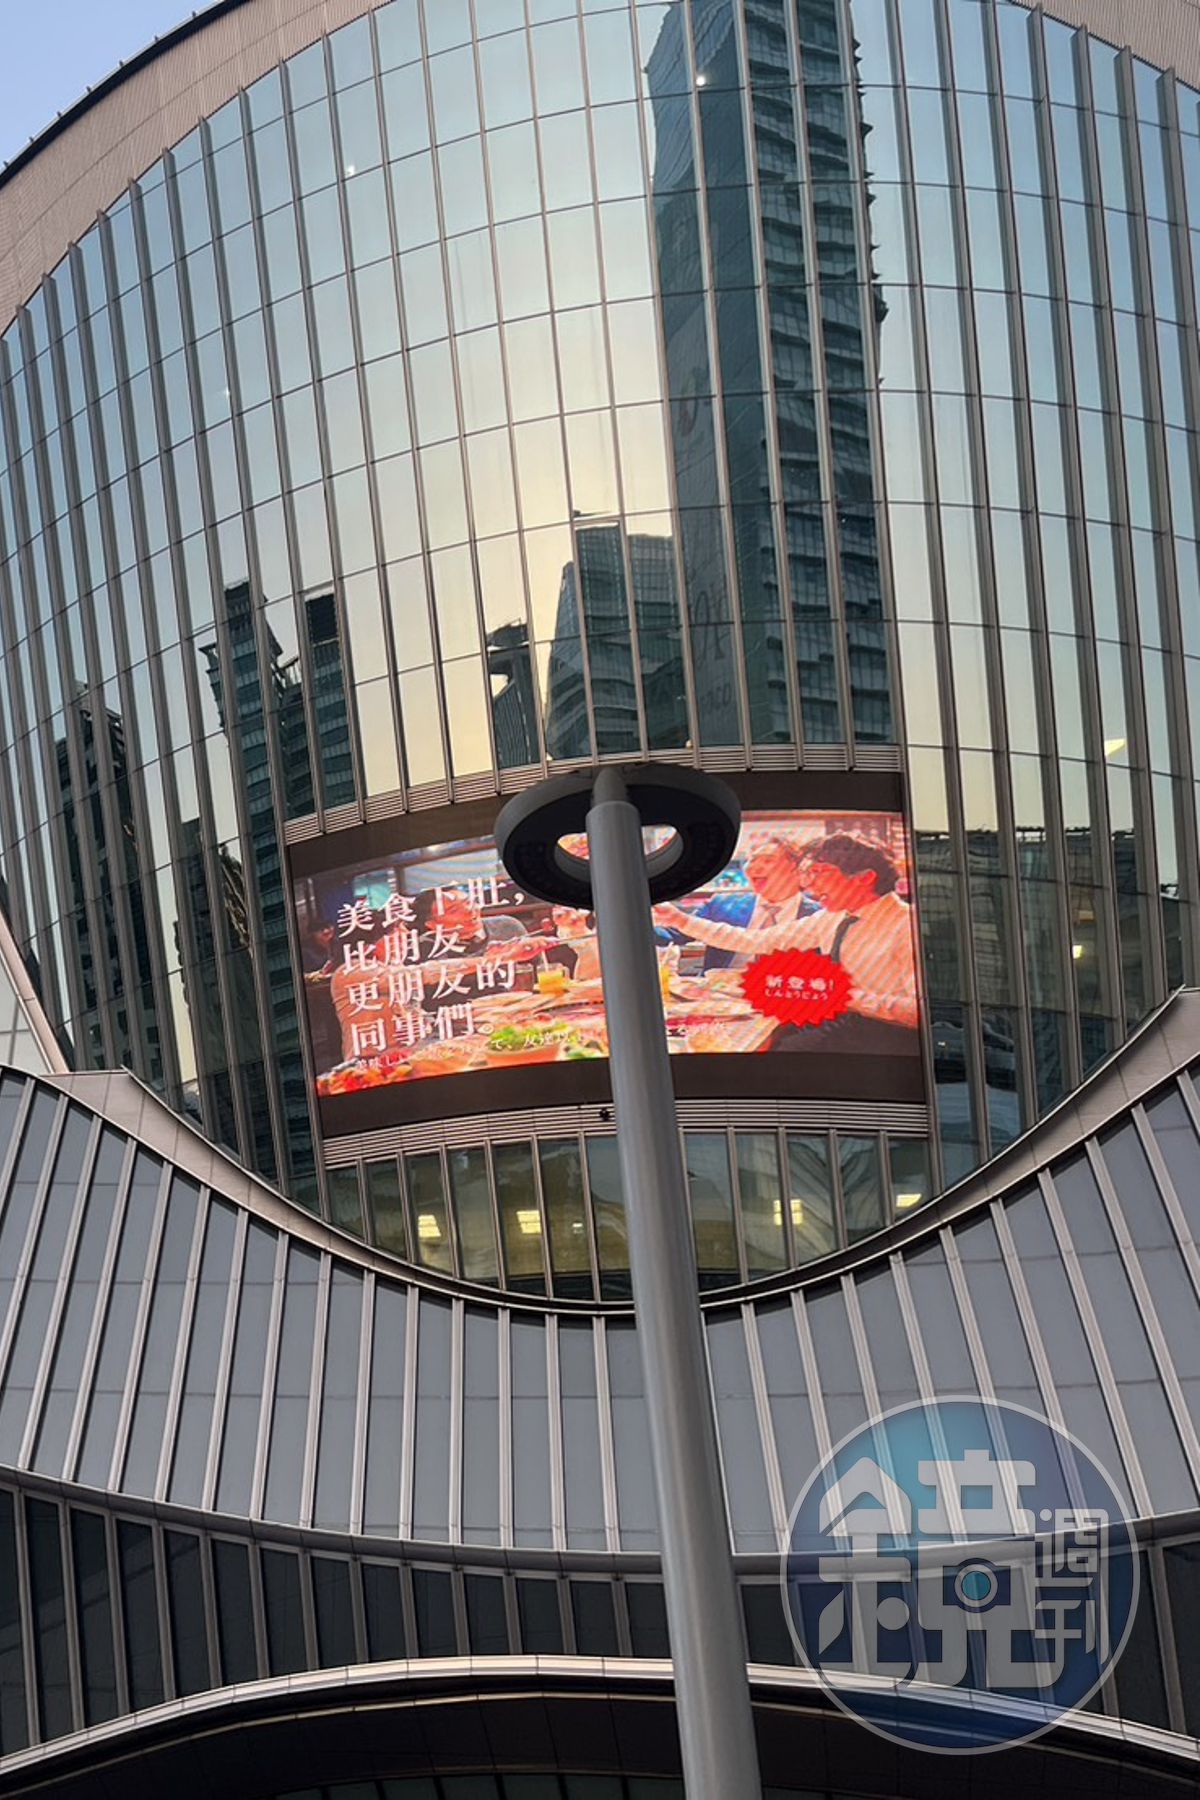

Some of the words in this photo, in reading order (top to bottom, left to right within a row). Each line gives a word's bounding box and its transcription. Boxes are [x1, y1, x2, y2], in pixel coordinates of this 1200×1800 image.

[342, 924, 466, 976] 比朋友
[345, 960, 517, 1016] 更朋友的
[350, 1003, 495, 1056] 同事們。
